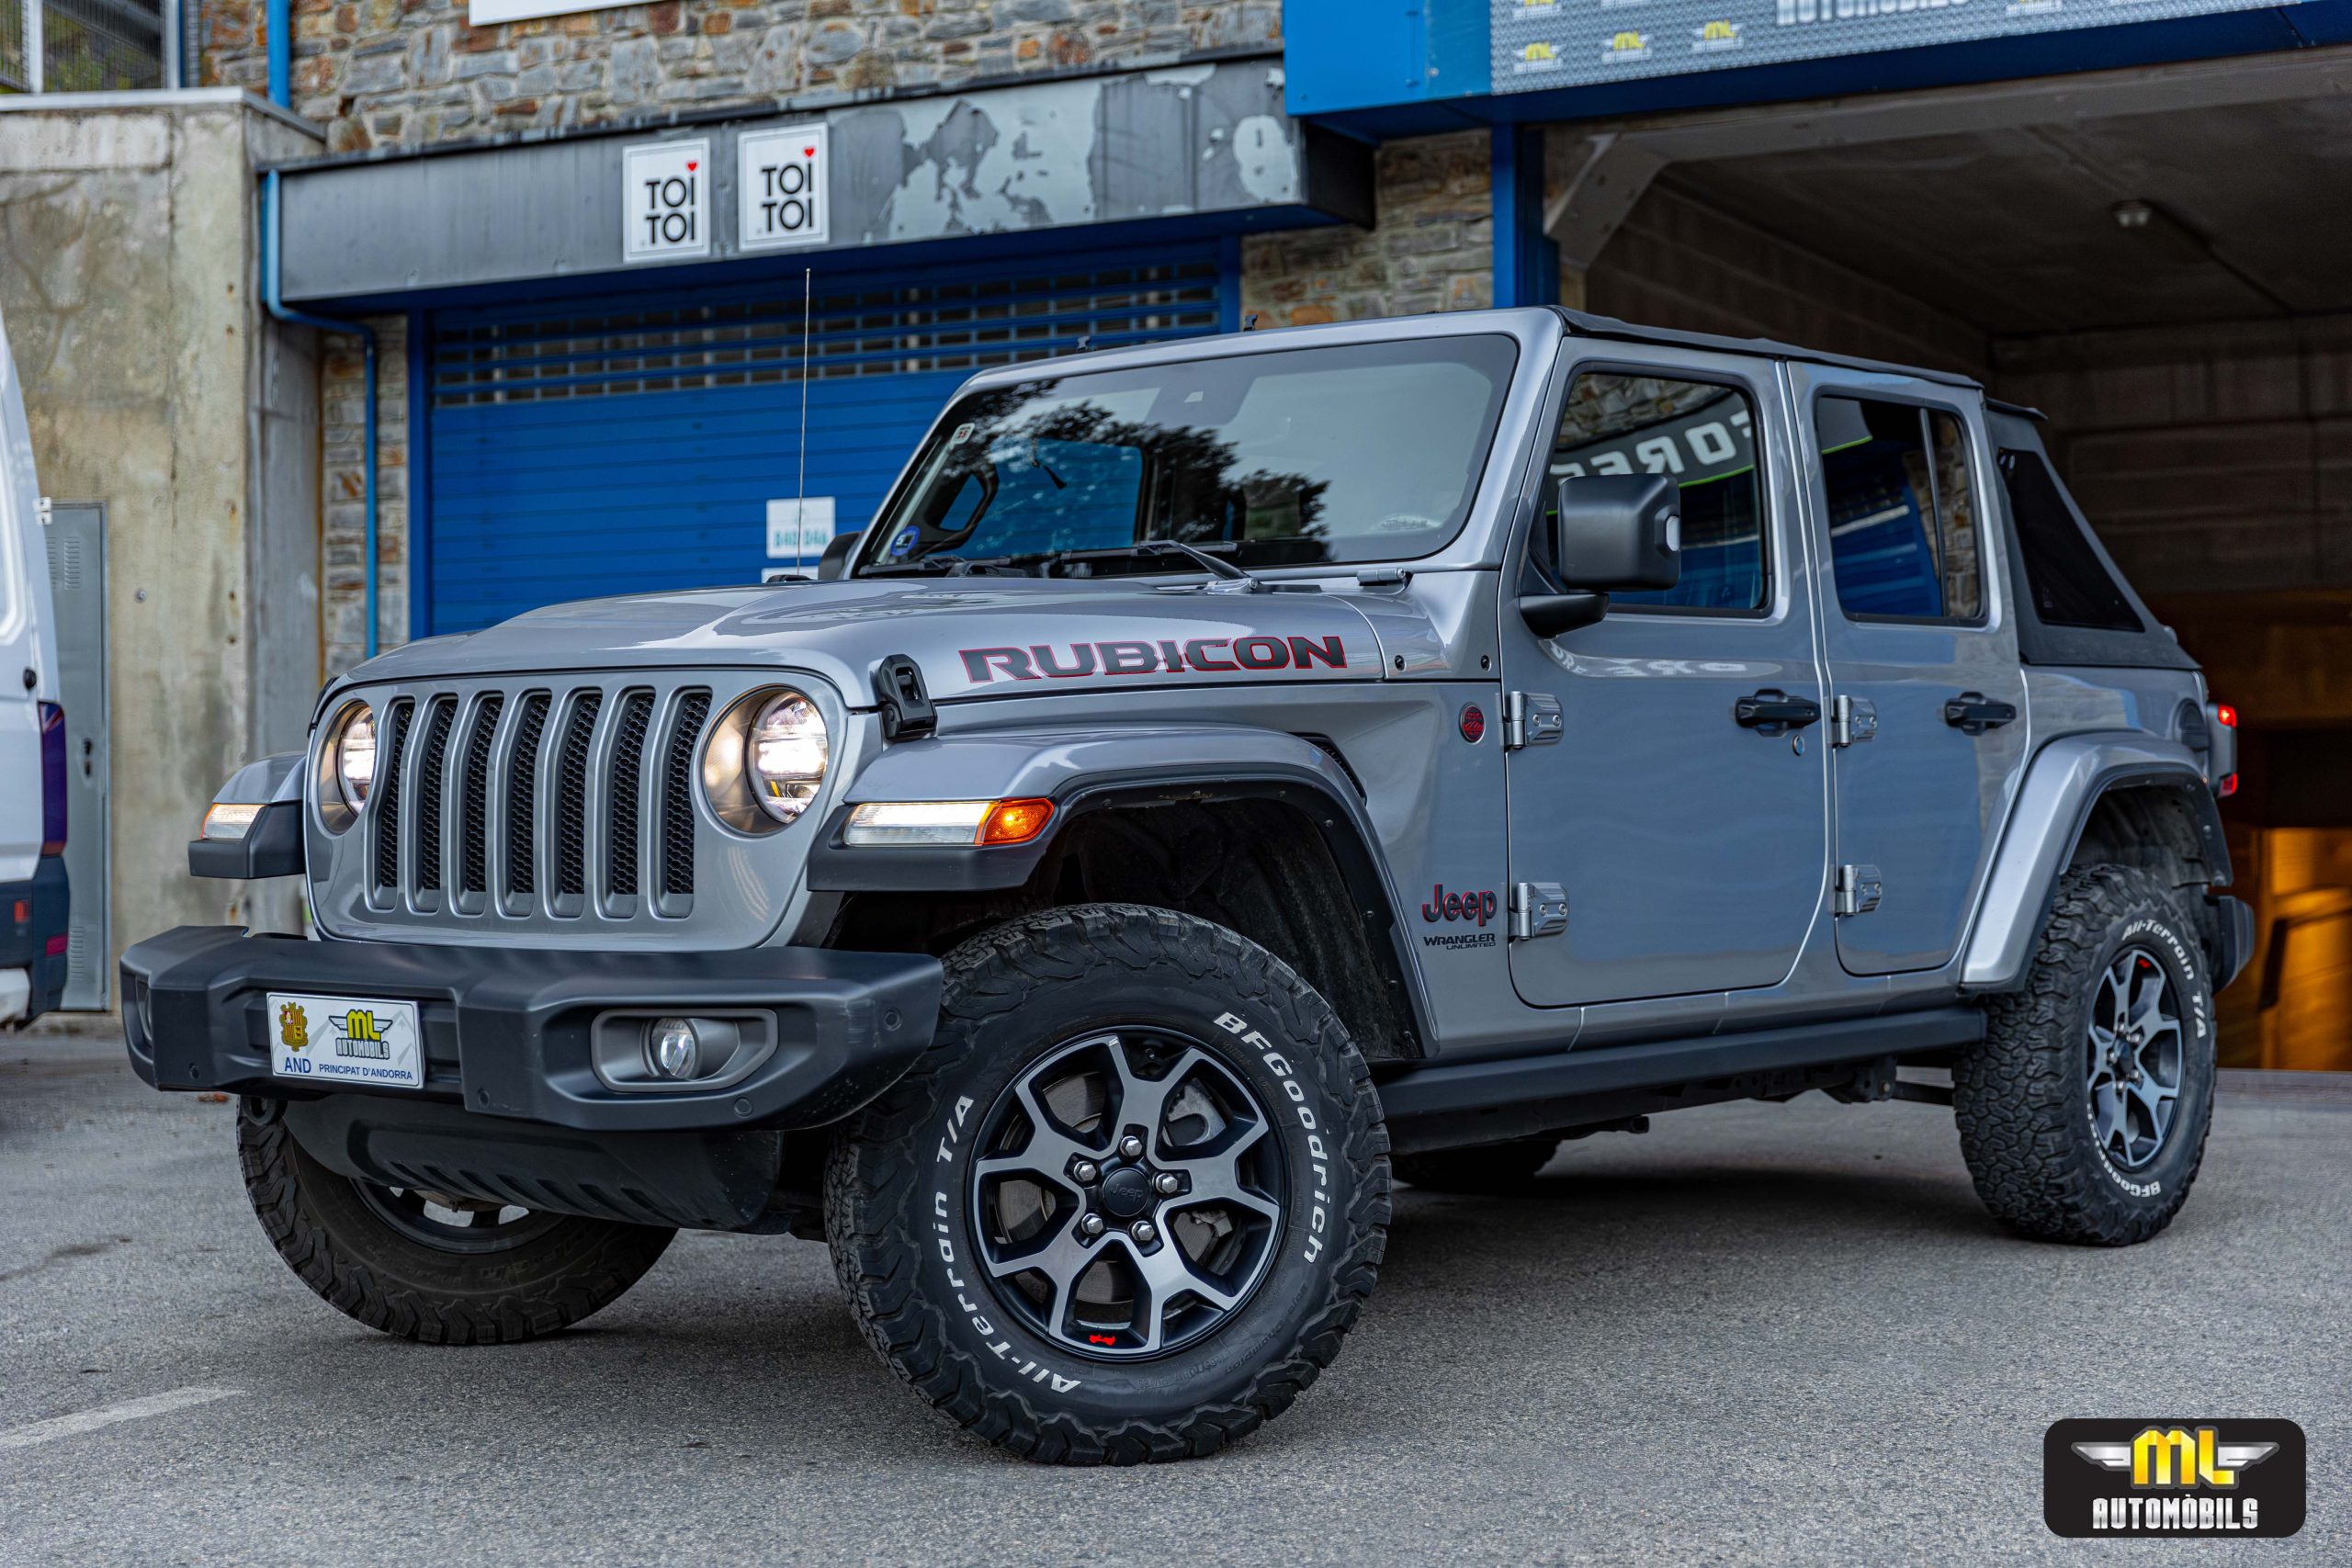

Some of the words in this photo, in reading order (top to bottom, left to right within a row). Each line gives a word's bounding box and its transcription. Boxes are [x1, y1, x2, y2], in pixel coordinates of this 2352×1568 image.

[645, 175, 695, 209] TOI
[762, 161, 813, 197] TOI
[645, 210, 695, 243] TOI
[762, 197, 813, 232] TOI
[958, 636, 1348, 683] RUBICON
[1421, 884, 1498, 927] Jeep
[1423, 932, 1496, 947] WRANGLER
[1446, 942, 1497, 950] UNLIMITED
[2121, 919, 2194, 981] All-Terrain
[2192, 991, 2206, 1038] T/A
[346, 1009, 381, 1042] ML
[284, 1056, 311, 1074] AND
[318, 1064, 360, 1077] PRINCIPAT
[362, 1067, 413, 1080] D'ANDORRA
[936, 1095, 974, 1162] T/A
[1213, 1011, 1330, 1263] BFGoodrich
[1112, 1182, 1144, 1202] Jeep
[933, 1191, 1081, 1393] All-Terrain
